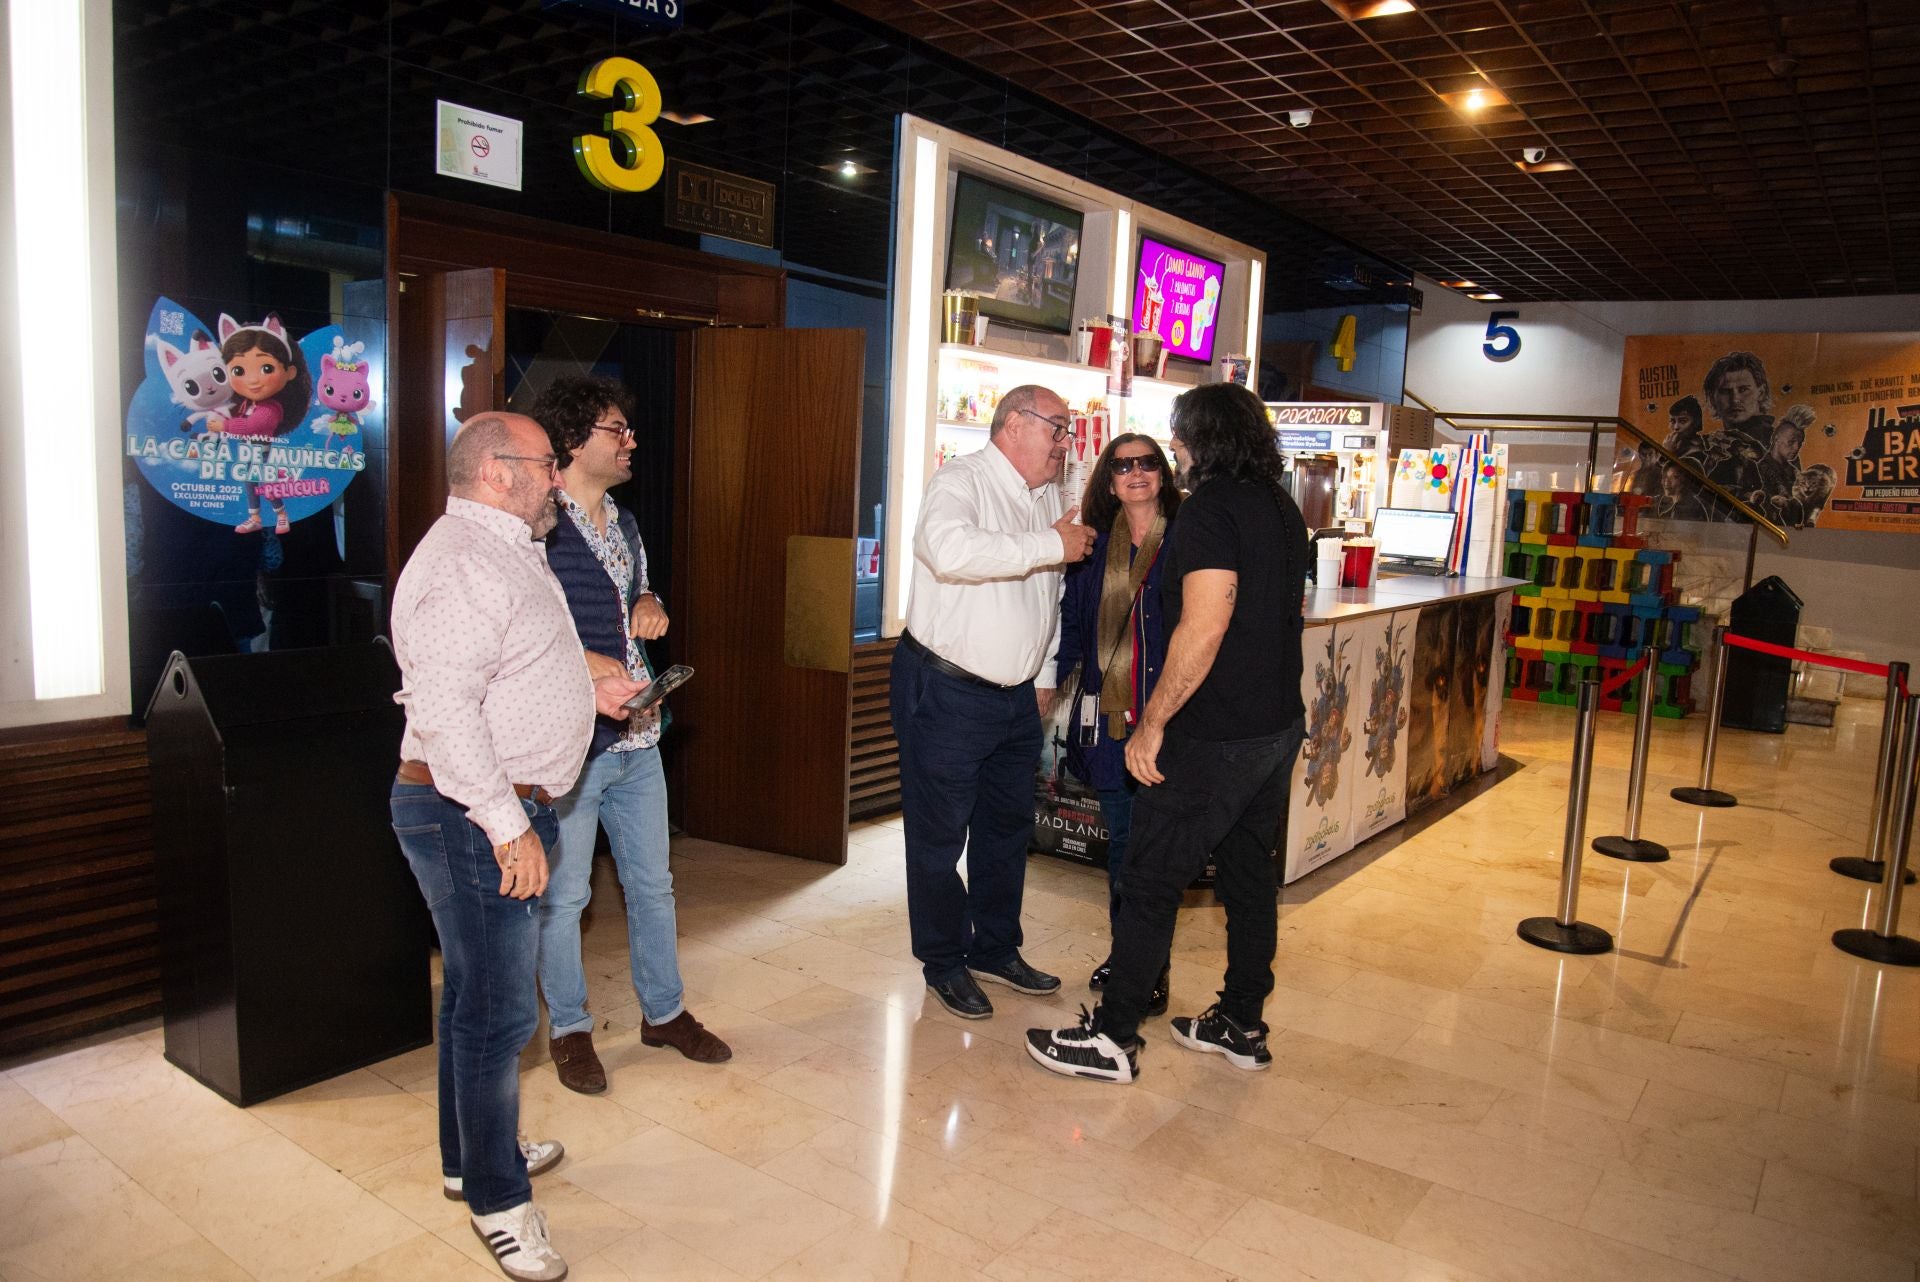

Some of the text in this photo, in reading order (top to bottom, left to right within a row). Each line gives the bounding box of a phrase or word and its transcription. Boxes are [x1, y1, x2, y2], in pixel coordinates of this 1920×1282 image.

[457, 117, 504, 134] Prohibido fumar
[584, 56, 665, 192] 3
[719, 187, 760, 210] DOLBY
[1165, 254, 1206, 280] COMBO GRANDE
[1170, 278, 1175, 293] 2
[1170, 299, 1175, 314] 2
[1331, 314, 1357, 372] 4
[1483, 311, 1521, 360] 5
[1639, 364, 1678, 384] AUSTIN
[1874, 375, 1904, 388] KRAVITZ
[1640, 380, 1680, 400] BUTLER
[1829, 392, 1860, 406] VINCENT
[1277, 407, 1349, 424] POPCORN
[127, 436, 366, 471] LA CASA DE MUÑECAS
[200, 460, 304, 483] DE GABBY
[171, 482, 243, 494] OCTUBRE 2025
[174, 491, 240, 502] EXCLUSIVAMENTE
[1864, 488, 1874, 497] UN
[1875, 487, 1900, 498] PEQUEÑO
[190, 500, 225, 509] EN CINES
